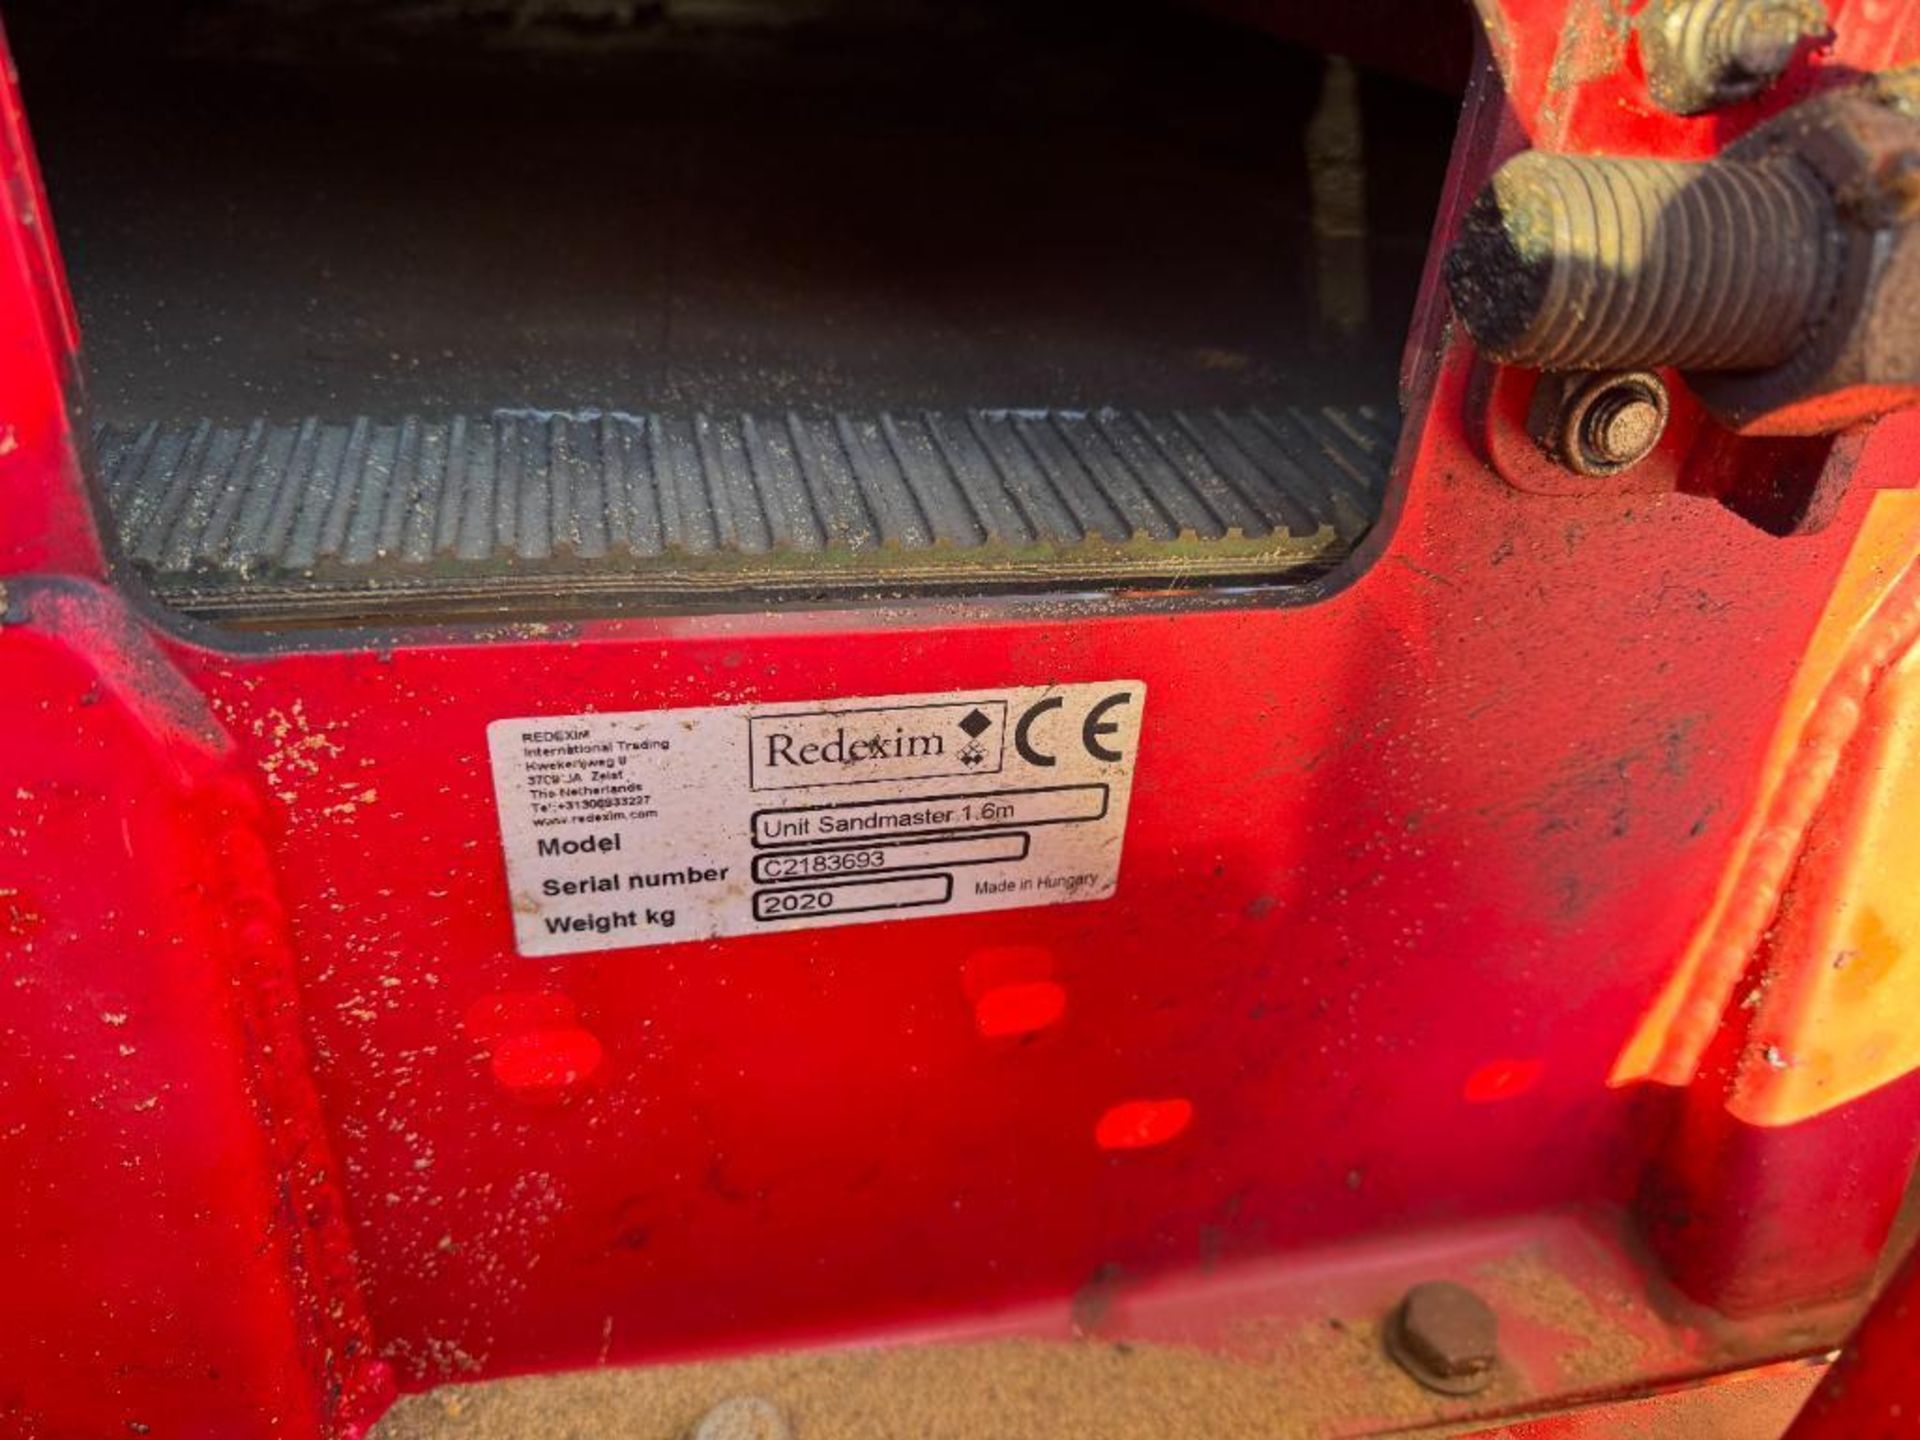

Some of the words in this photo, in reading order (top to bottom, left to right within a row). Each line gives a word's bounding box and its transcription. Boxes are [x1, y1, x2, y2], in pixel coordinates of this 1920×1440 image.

[522, 730, 590, 743] REDEXIM
[524, 742, 613, 757] International
[617, 739, 670, 752] Trading
[766, 728, 944, 768] Redexim
[763, 816, 810, 838] Unit
[818, 809, 954, 833] Sandmaster
[961, 802, 1015, 822] 1.6m
[537, 833, 621, 857] Model
[763, 851, 885, 877] C2183693
[542, 875, 620, 896] Serial
[629, 867, 729, 890] number
[974, 878, 1015, 895] Made
[1019, 877, 1033, 892] in
[1036, 872, 1098, 891] Hungary
[763, 892, 834, 914] 2020
[544, 911, 637, 935] Weight
[646, 907, 676, 927] kg
